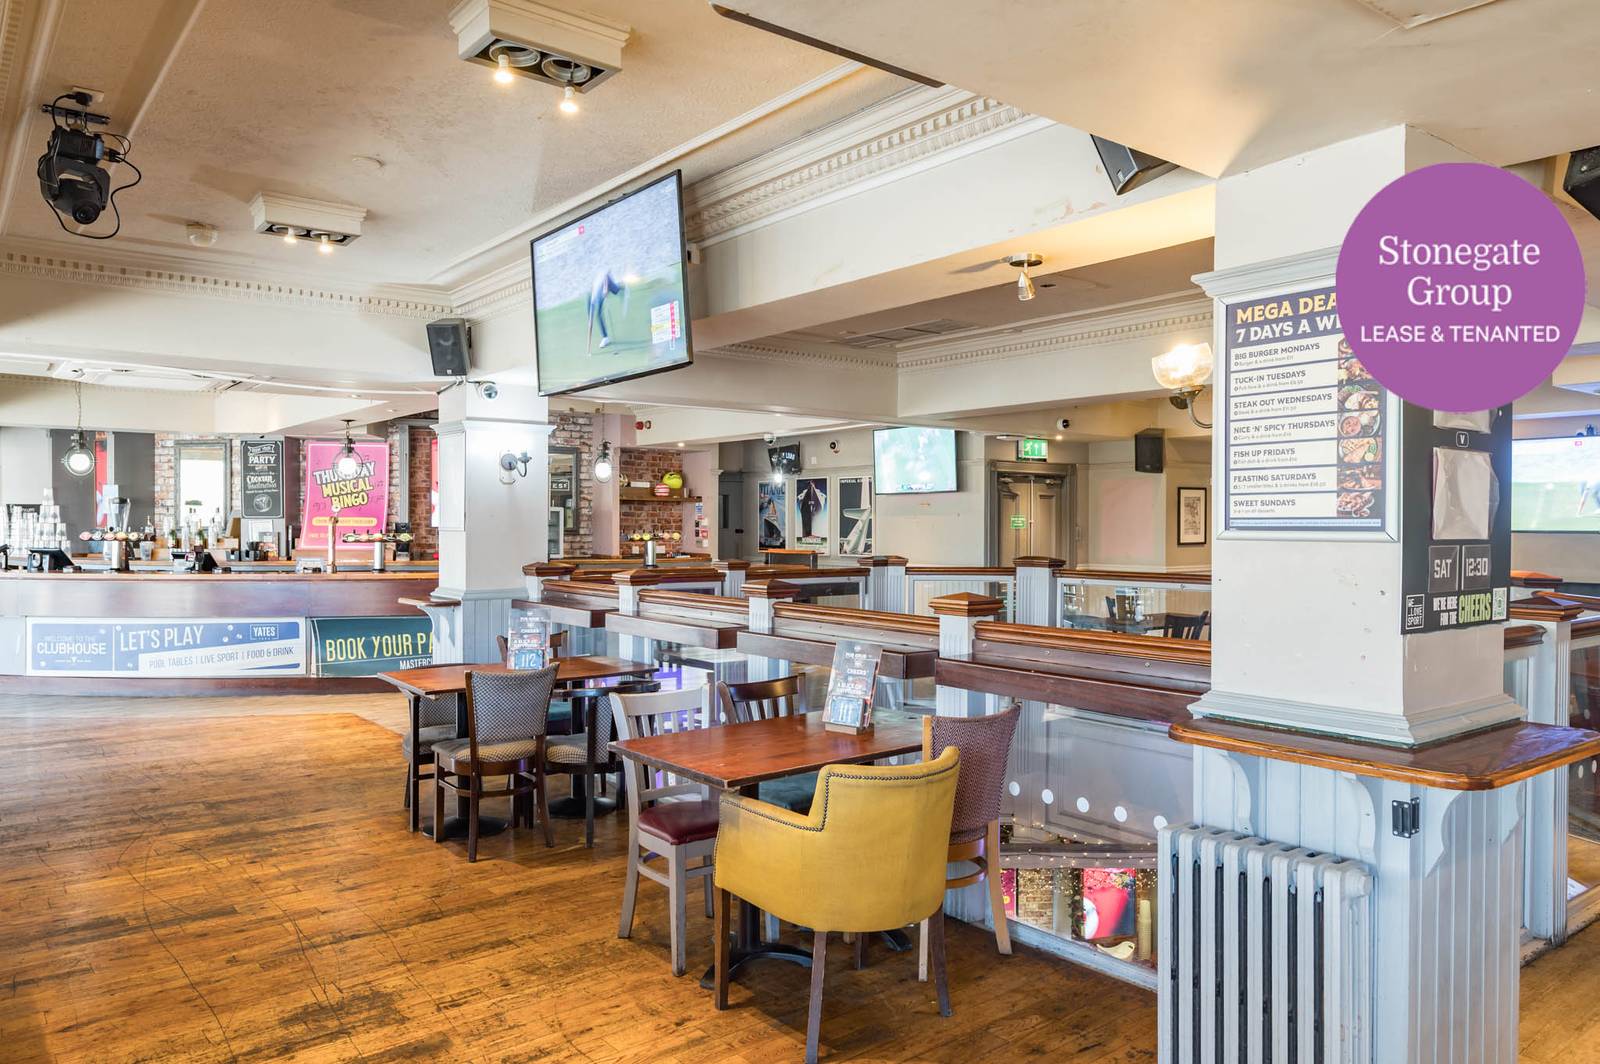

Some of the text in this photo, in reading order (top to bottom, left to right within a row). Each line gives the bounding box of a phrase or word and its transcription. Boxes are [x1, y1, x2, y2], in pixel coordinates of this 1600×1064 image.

[1236, 292, 1337, 325] MEGA DEA
[1235, 328, 1246, 344] 7
[1249, 321, 1294, 341] DAYS
[1297, 319, 1311, 335] A
[1234, 343, 1320, 361] BIG BURGER MONDAYS
[1234, 370, 1306, 385] TUCK-IN TUESDAYS
[1234, 393, 1332, 409] STEAK OUT WEDNESDAYS
[1234, 426, 1251, 435] NICE
[1264, 424, 1286, 432] SPICY
[1288, 420, 1335, 430] THURSDAYS
[1459, 434, 1466, 445] V
[249, 456, 275, 464] PARTY
[1233, 448, 1296, 458] FISH UP FRIDAYS
[1233, 473, 1317, 483] FEASTING SATURDAYS
[322, 477, 374, 498] MUSICAL
[331, 492, 368, 509] BINGO
[1260, 499, 1296, 507] SUNDAYS
[1434, 558, 1488, 579] SAT 12:30
[1458, 592, 1492, 624] CHEERS
[120, 625, 204, 652] LET'S PLAY
[253, 627, 276, 637] YATES
[37, 642, 107, 655] CLUBHOUSE
[325, 637, 367, 661] BOOK
[371, 633, 412, 658] YOUR
[168, 655, 193, 667] TABLES
[201, 655, 216, 665] LIVE
[217, 651, 239, 663] SPORT
[247, 649, 265, 659] FOOD
[266, 648, 271, 657] &
[273, 646, 294, 657] DRINK
